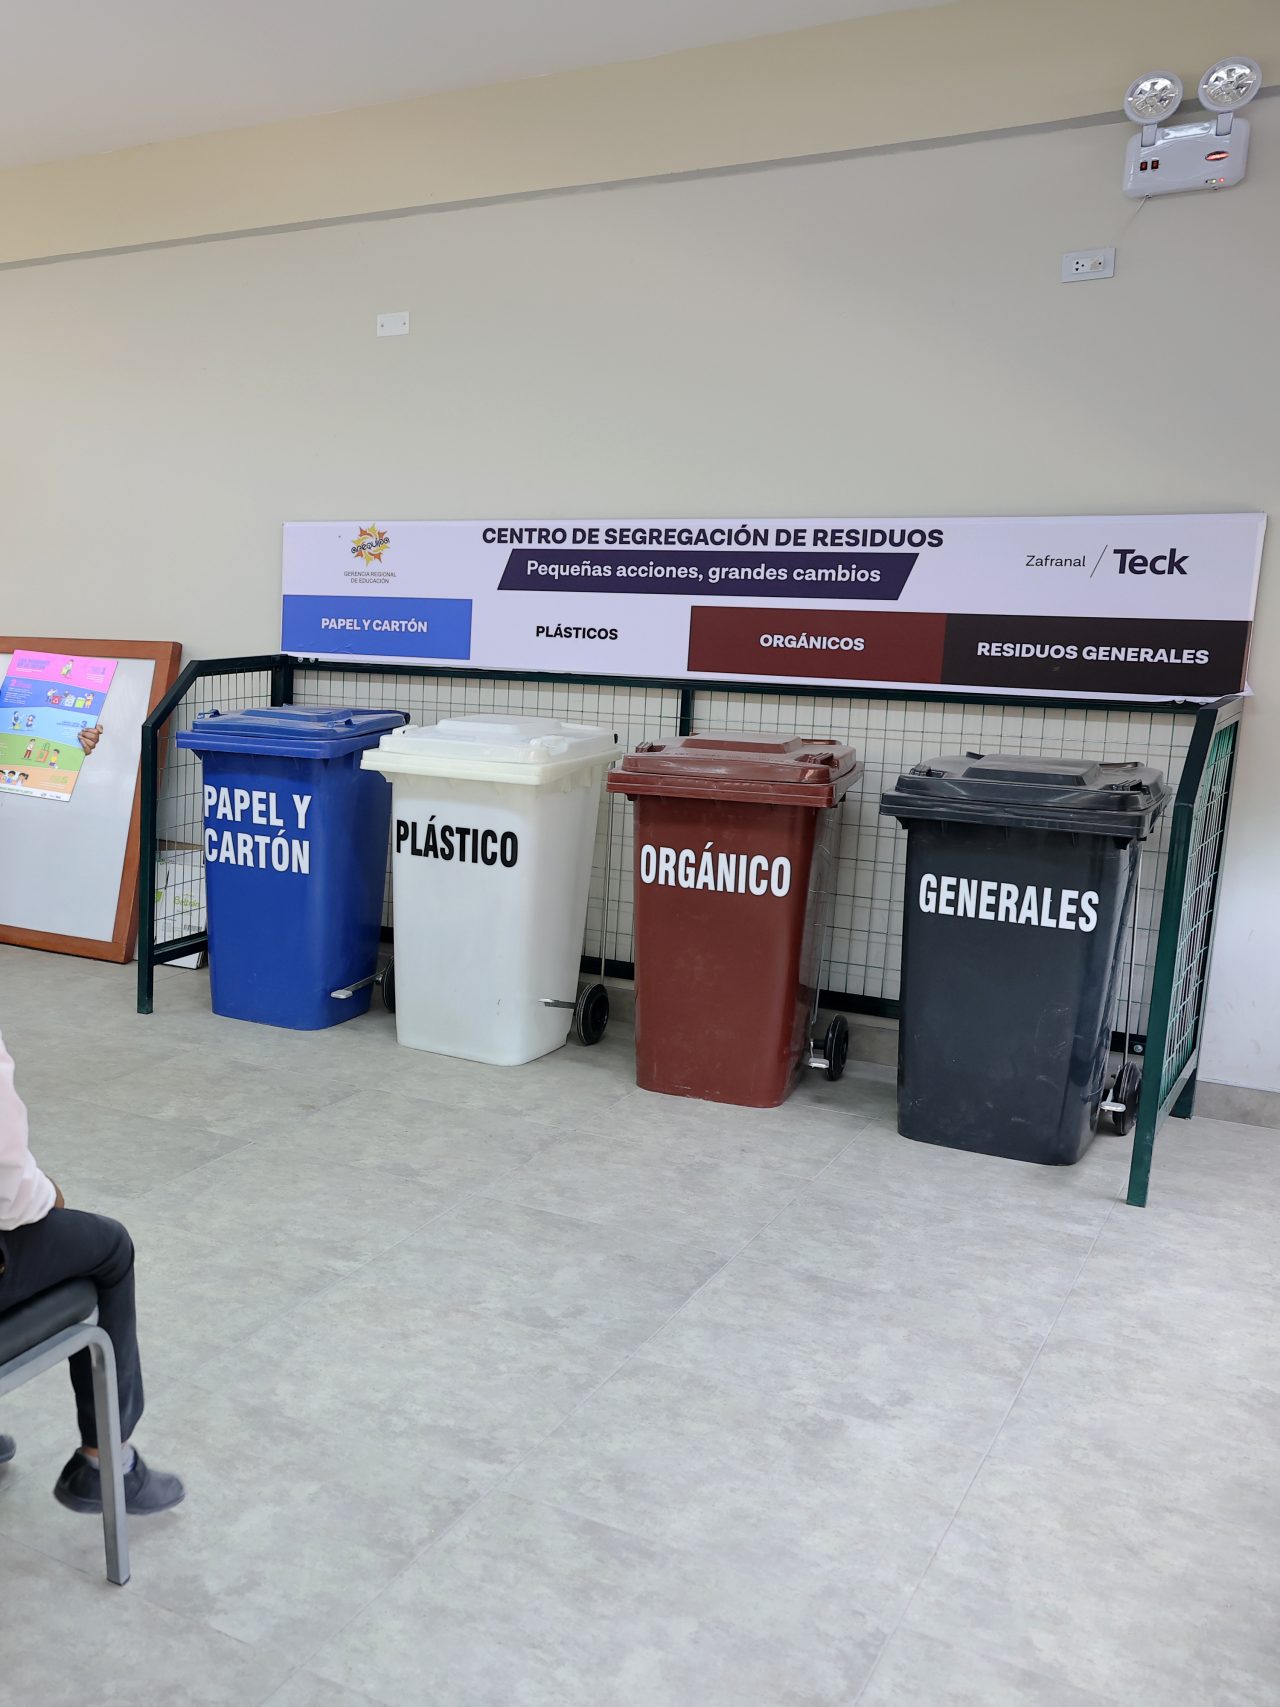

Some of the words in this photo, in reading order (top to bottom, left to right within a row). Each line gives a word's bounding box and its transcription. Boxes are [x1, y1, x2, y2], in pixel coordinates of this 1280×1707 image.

[482, 527, 567, 545] CENTRO
[571, 527, 600, 545] DE
[605, 523, 769, 546] SEGREGACIÓN
[774, 528, 807, 547] DE
[812, 528, 944, 548] RESIDUOS
[527, 559, 612, 580] Pequeñas
[615, 560, 704, 583] acciones,
[708, 562, 788, 584] grandes
[792, 564, 881, 584] cambios
[1025, 554, 1086, 568] Zafranal
[1112, 547, 1190, 576] Teck
[321, 617, 361, 631] PAPEL
[362, 618, 372, 631] Y
[373, 616, 428, 634] CARTÓN
[535, 623, 619, 641] PLÁSTICOS
[759, 632, 865, 652] ORGÁNICOS
[976, 641, 1078, 661] RESIDUOS
[1081, 645, 1210, 666] GENERALES
[203, 783, 283, 828] PAPEL
[292, 794, 312, 830] Y
[204, 824, 310, 876] CARTÓN
[396, 814, 519, 868] PLÁSTICO
[640, 841, 791, 898] ORGÁNICO
[919, 873, 1099, 933] GENERALES
